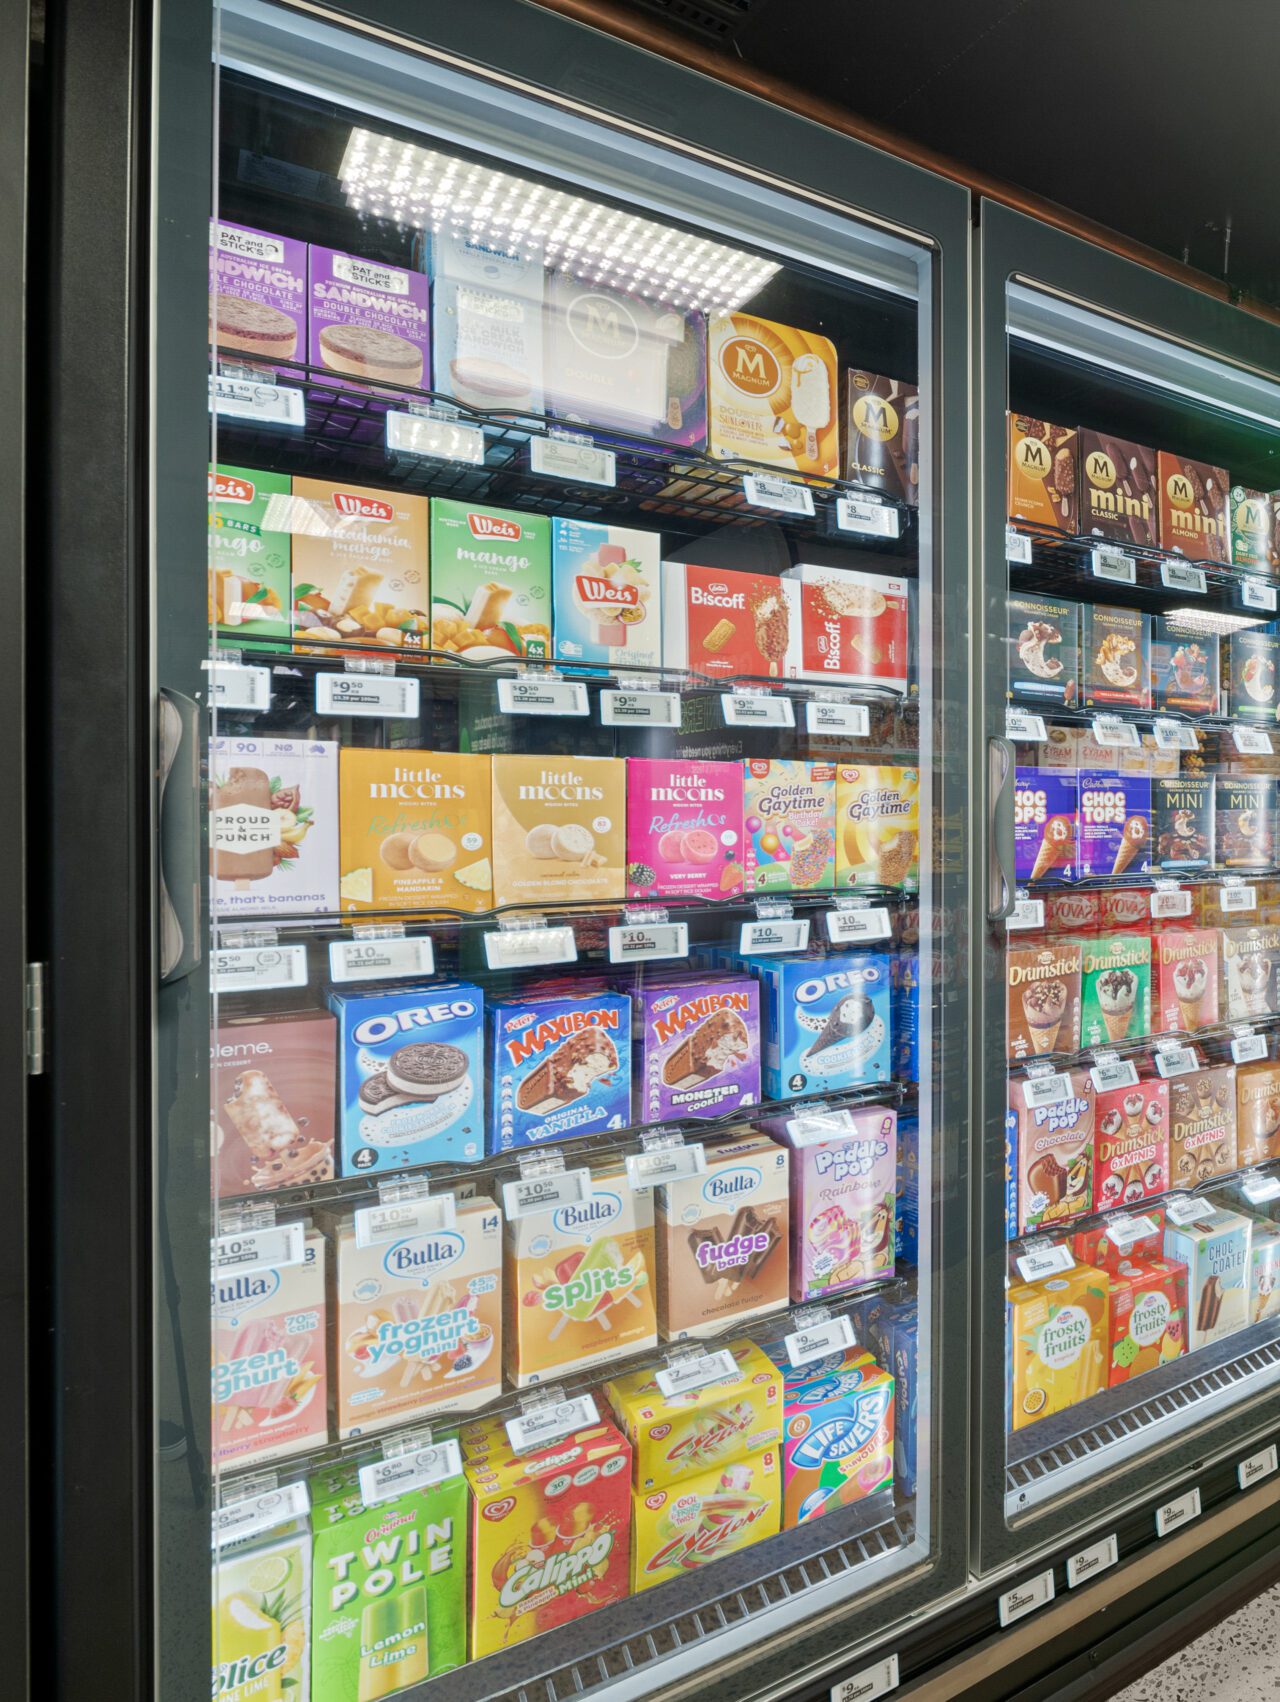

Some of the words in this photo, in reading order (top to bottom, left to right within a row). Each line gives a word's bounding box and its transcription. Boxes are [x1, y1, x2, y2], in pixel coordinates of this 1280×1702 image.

[220, 239, 264, 256] STICK'S
[221, 232, 242, 242] PAT
[244, 239, 263, 248] and
[352, 265, 371, 276] PAT
[374, 272, 391, 281] and
[352, 272, 391, 289] STICK'S
[233, 278, 293, 300] CHOCOLATE
[313, 282, 427, 323] SANDWICH
[323, 301, 360, 316] DOUBLE
[364, 309, 419, 330] CHOCOLATE
[733, 372, 770, 387] MAGNUM
[851, 462, 886, 476] CLASSIC
[1021, 460, 1047, 472] MAGNUM
[1090, 474, 1113, 483] MAGNUM
[338, 494, 391, 519] Weis
[1089, 487, 1152, 521] mini
[1091, 508, 1119, 521] CLASSIC
[1169, 506, 1227, 538] mini
[227, 519, 258, 535] BARS
[475, 515, 517, 537] Weis
[1171, 529, 1199, 539] ALMOND
[332, 541, 391, 561] mango
[456, 546, 532, 571] mango
[583, 577, 635, 603] Weis
[691, 586, 746, 610] Biscoff
[1013, 600, 1070, 616] CONNOISSEUR
[1093, 614, 1144, 627] CONNOISSEUR
[404, 632, 422, 646] 4x
[1166, 625, 1213, 637] CONNOISSEUR
[529, 643, 546, 657] 4x
[824, 621, 841, 670] Biscoff
[236, 743, 257, 754] 90
[394, 767, 442, 783] little
[541, 771, 583, 786] little
[669, 773, 706, 787] little
[369, 783, 466, 800] moons
[519, 784, 603, 801] moons
[651, 786, 725, 801] moons
[771, 785, 813, 799] Golden
[861, 790, 900, 803] Golden
[1081, 791, 1126, 808] CHOC
[1166, 794, 1203, 809] MINI
[1230, 794, 1264, 809] MINI
[758, 795, 825, 815] Gaytime
[849, 801, 910, 818] Gaytime
[1082, 806, 1126, 823] TOPS
[215, 815, 271, 825] PROUD
[788, 810, 823, 821] Birthday
[215, 833, 271, 843] PUNCH
[393, 878, 435, 886] PINEAPPLE
[669, 872, 685, 880] VERY
[685, 872, 707, 880] BERRY
[231, 894, 266, 905] that's
[269, 892, 326, 904] bananas
[396, 885, 441, 893] MANDARIN
[1162, 940, 1218, 965] Drumstick
[1225, 934, 1280, 959] Drumstick
[1008, 957, 1081, 986] Drumstick
[1083, 948, 1150, 975] Drumstick
[794, 967, 881, 1004] OREO
[651, 995, 680, 1012] Peters
[353, 1000, 477, 1047] OREO
[505, 1013, 536, 1032] Peters
[654, 992, 750, 1045] MAXIBON
[508, 1009, 619, 1067] MAXIBON
[671, 1084, 739, 1105] MONSTER
[687, 1095, 724, 1113] COOKIE
[544, 1103, 589, 1123] ORIGINAL
[1034, 1097, 1089, 1127] Paddle
[526, 1107, 608, 1142] VANILLA
[1173, 1111, 1233, 1142] Drumstick
[1034, 1131, 1086, 1152] Chocolate
[1100, 1128, 1164, 1162] Drumstick
[775, 1153, 785, 1166] 8
[815, 1140, 889, 1176] Paddle
[709, 1174, 757, 1197] Bulla
[819, 1178, 882, 1202] Rainbow
[482, 1216, 499, 1230] 14
[561, 1201, 616, 1228] Bulla
[392, 1241, 458, 1270] Bulla
[697, 1233, 769, 1265] fudge
[1208, 1239, 1234, 1261] CHOC
[717, 1255, 749, 1272] bars
[1211, 1250, 1247, 1275] COATED
[469, 1277, 487, 1290] 45
[470, 1283, 496, 1296] cals
[543, 1264, 635, 1310] splits
[701, 1298, 741, 1317] chocolate
[741, 1294, 764, 1308] fudge
[1131, 1301, 1168, 1328] frosty
[288, 1321, 318, 1334] cals
[379, 1306, 469, 1343] frozen
[1042, 1316, 1088, 1348] frosty
[1133, 1315, 1168, 1337] fruits
[367, 1318, 480, 1365] yoghurt
[420, 1339, 458, 1358] mini
[581, 1334, 619, 1350] raspberry
[1043, 1333, 1087, 1359] fruits
[805, 1385, 832, 1403] LIFE
[828, 1371, 863, 1398] SAVERS
[253, 1424, 311, 1445] strawberry
[828, 1396, 885, 1456] SAVERS
[799, 1420, 846, 1460] LIFE
[846, 1426, 889, 1470] FLAVOURS
[364, 1510, 417, 1544] Original
[329, 1517, 452, 1581] TWIN
[331, 1545, 453, 1612] POLE
[499, 1532, 613, 1609] Calippo
[557, 1569, 595, 1596] Mini
[360, 1621, 425, 1657] Lemon
[369, 1644, 417, 1669] Lime
[244, 1679, 270, 1698] LIME
